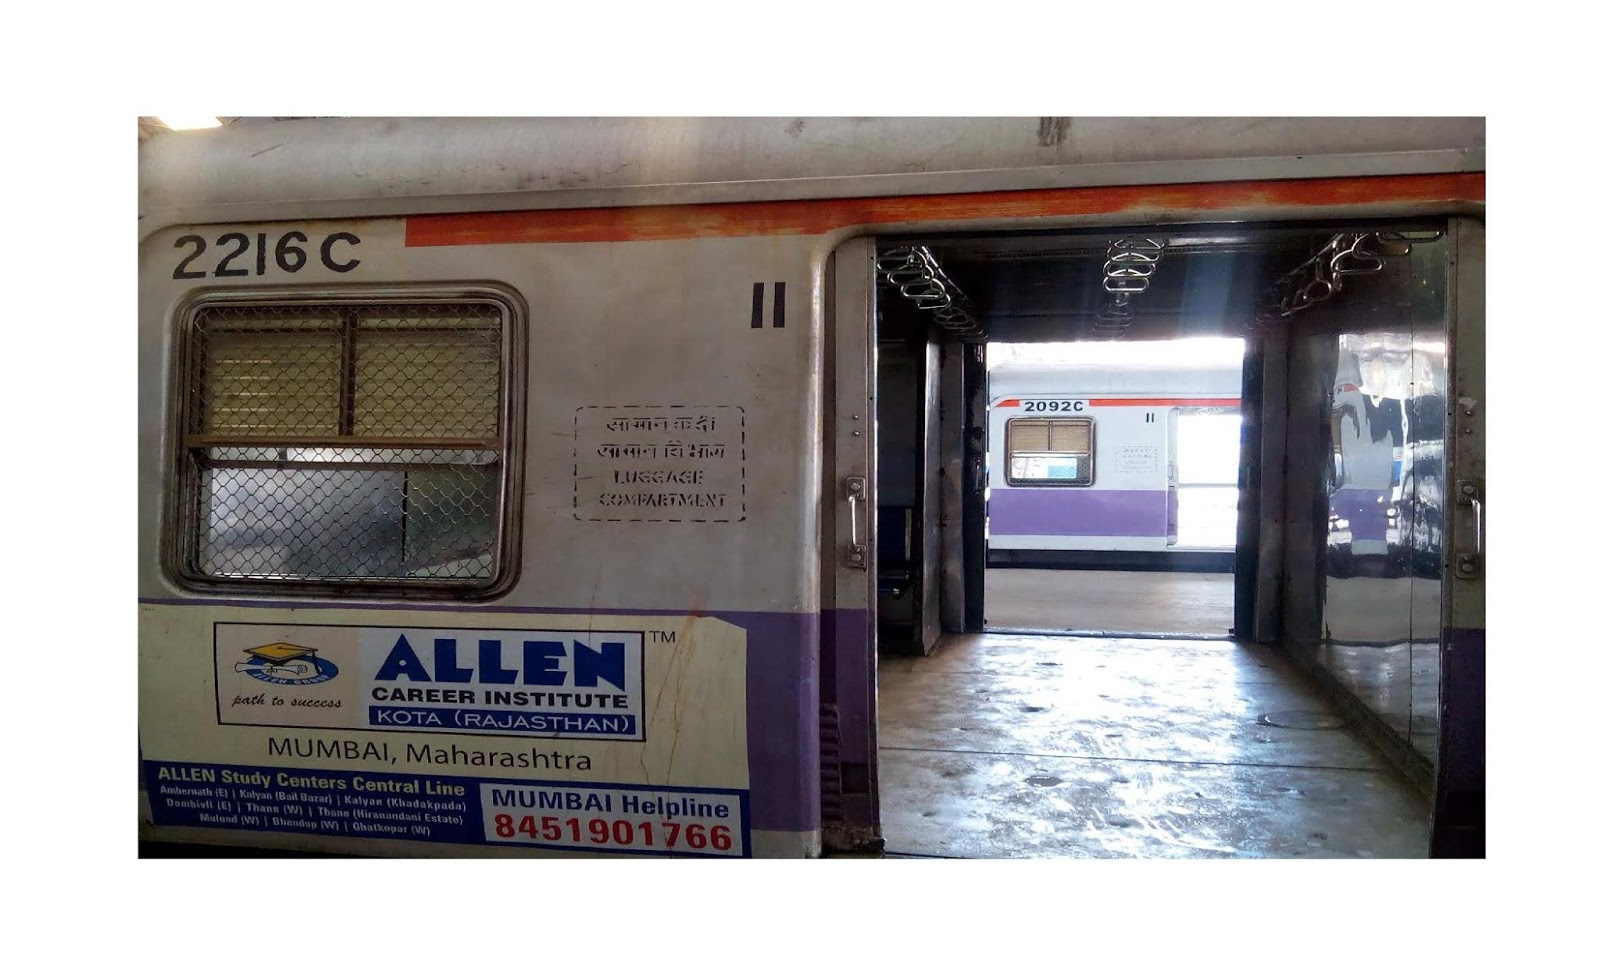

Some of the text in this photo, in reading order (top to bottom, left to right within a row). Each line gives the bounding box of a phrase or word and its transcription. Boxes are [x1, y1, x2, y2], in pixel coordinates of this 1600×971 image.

[1025, 401, 1083, 412] 2092C
[607, 417, 667, 432] सामान
[597, 443, 656, 459] सामान
[614, 470, 704, 484] LUGGAGE
[599, 493, 727, 507] COMPARTMENT
[649, 631, 676, 643] TM
[374, 634, 625, 692] ALLEN
[231, 693, 343, 708] path to success
[372, 687, 628, 709] CAREER INSTITUTE
[377, 709, 628, 732] KOTA (RAJASTHAN)
[268, 737, 592, 772] MUMBAI, Maharashtra
[158, 766, 465, 796] ALLEN Study Centers Central Line
[160, 785, 467, 812] Ambernath (E) Kalyan (Bail Bazar) Kalyan (Khadakpada)
[492, 789, 729, 819] MUMBAI Helpline
[217, 800, 231, 812] (E)
[246, 803, 279, 813] Thane
[283, 804, 303, 815] (W)
[318, 807, 350, 818] Thane
[353, 808, 421, 822] (Hiranandani
[425, 814, 463, 825] Estate)
[200, 813, 430, 837] Mulund (W) Bhandup (W) Ghatkopar (W)
[494, 814, 732, 850] 8451901766
